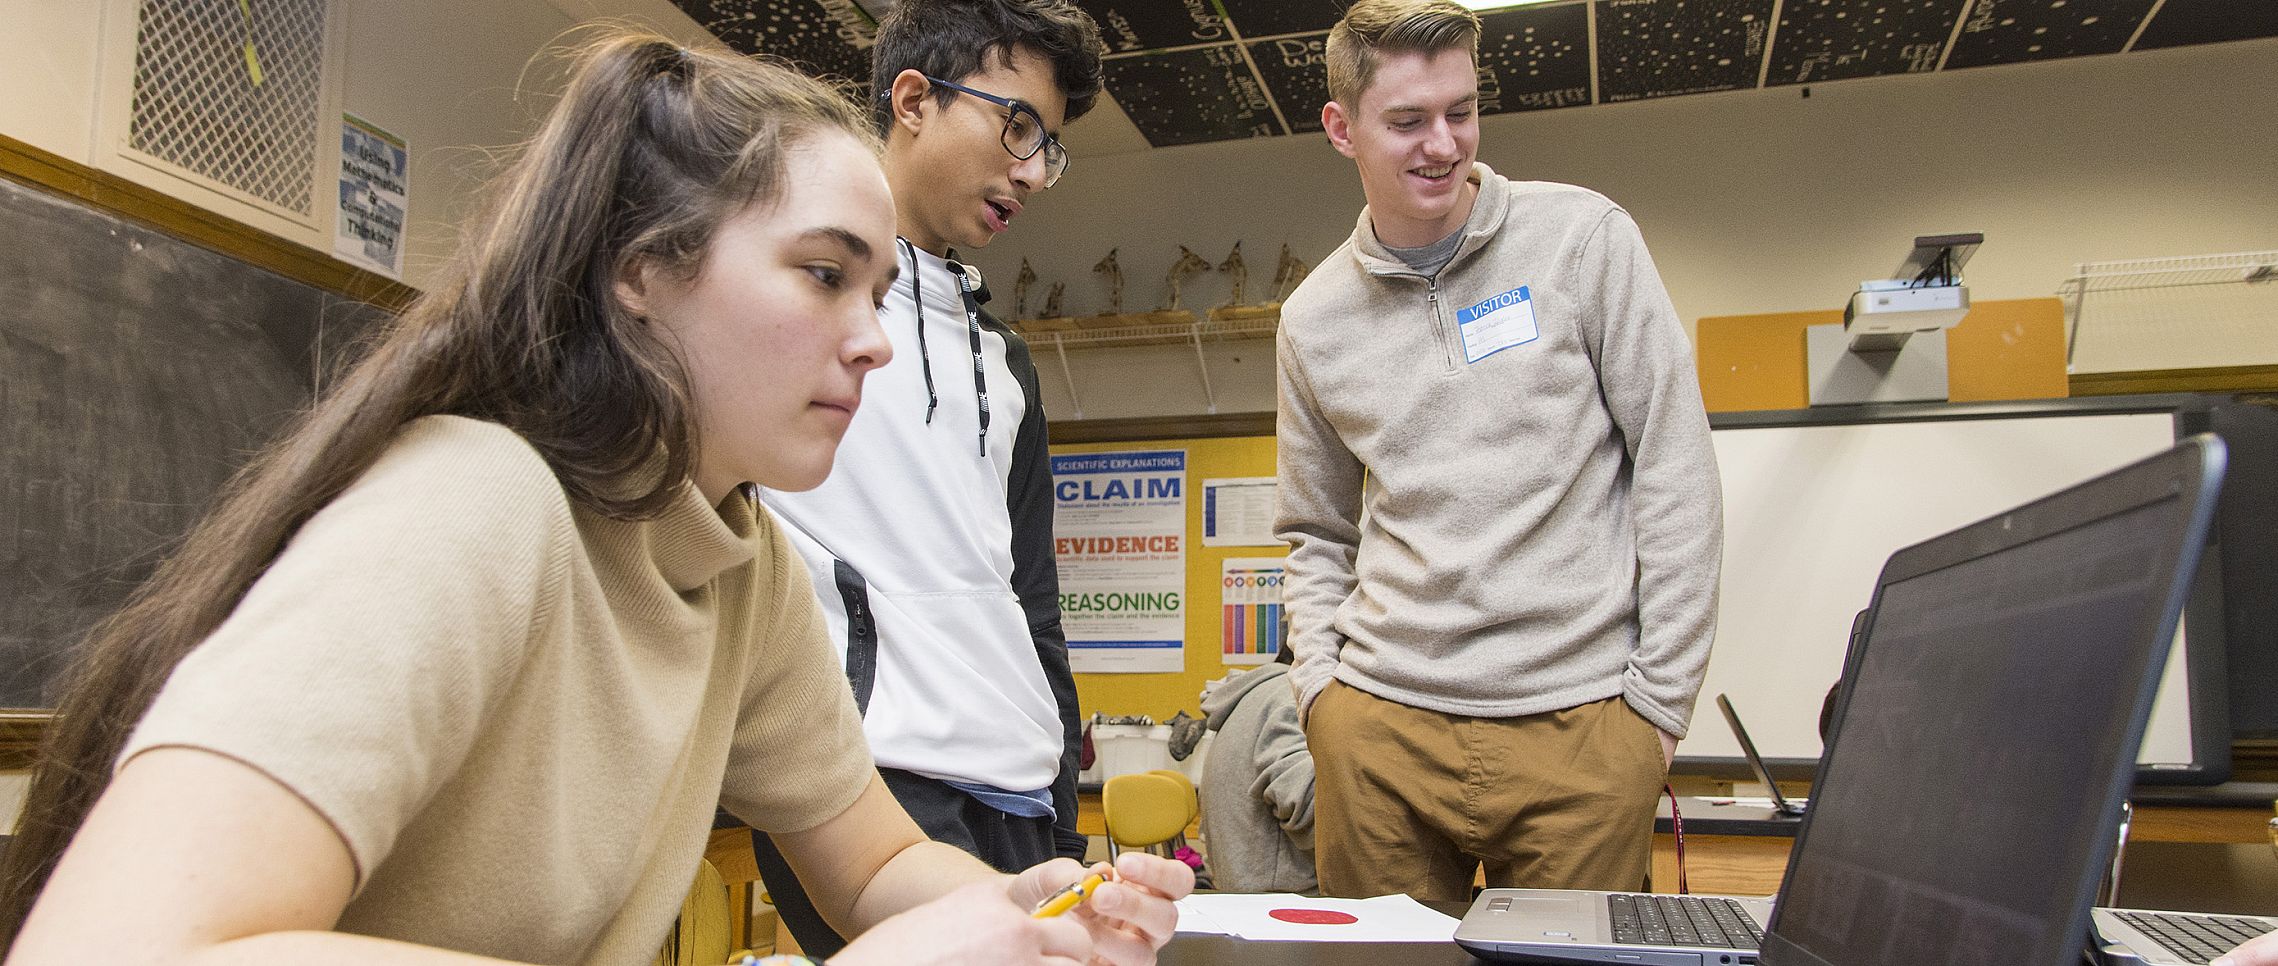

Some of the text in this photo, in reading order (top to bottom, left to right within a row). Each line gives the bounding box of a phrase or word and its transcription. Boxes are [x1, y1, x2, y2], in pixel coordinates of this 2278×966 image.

[359, 145, 391, 174] Using
[342, 158, 406, 196] Mathematics
[347, 218, 394, 251] Thinking
[1469, 289, 1522, 319] VISITOR
[1057, 457, 1181, 471] SCIENTIFIC EXPLANATIONS
[1056, 478, 1181, 501] CLAIM
[1055, 536, 1179, 554] EVIDENCE
[1059, 592, 1180, 612] REASONING
